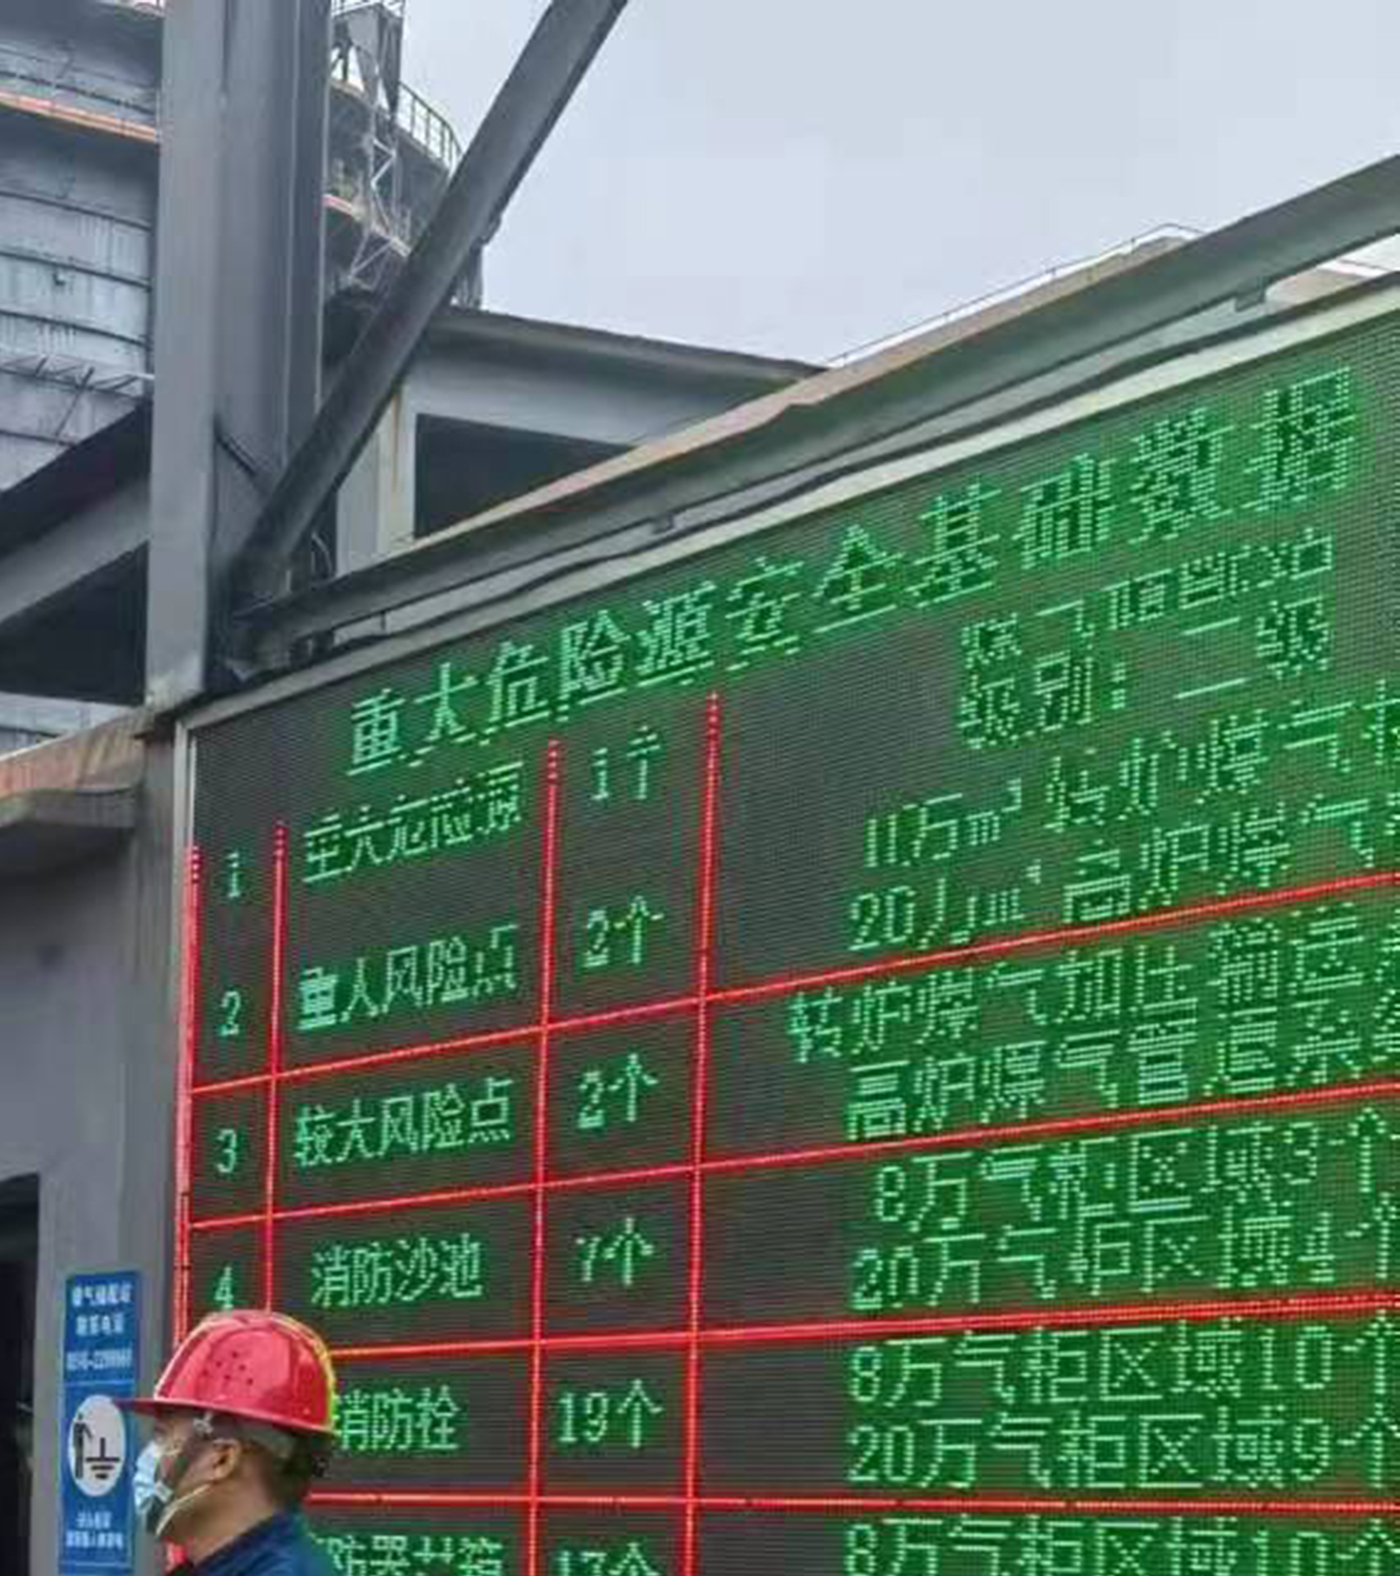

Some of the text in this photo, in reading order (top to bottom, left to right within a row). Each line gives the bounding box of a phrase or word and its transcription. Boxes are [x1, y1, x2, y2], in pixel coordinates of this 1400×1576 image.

[347, 366, 1356, 777] 重大危险源安全基础数据
[219, 990, 242, 1037] 2
[582, 894, 665, 969] 2个
[215, 1051, 659, 1175] 3 较大风险点 2个
[213, 1216, 656, 1310] 4 消防沙池 7个
[556, 1377, 665, 1450] 19个
